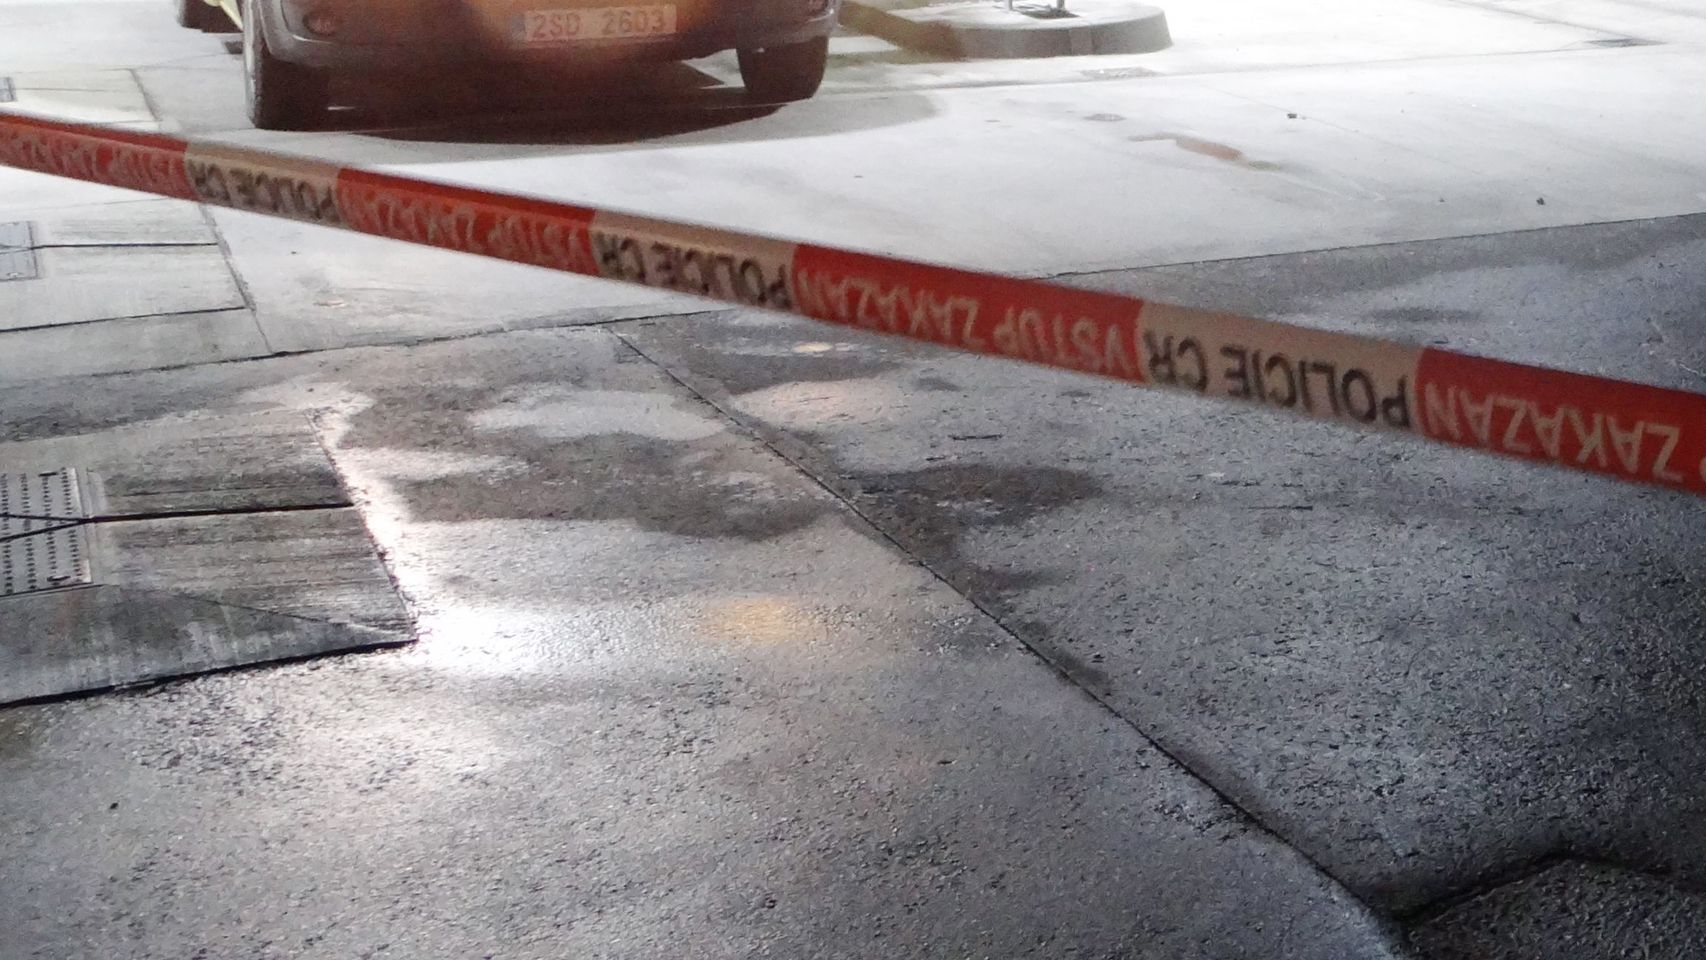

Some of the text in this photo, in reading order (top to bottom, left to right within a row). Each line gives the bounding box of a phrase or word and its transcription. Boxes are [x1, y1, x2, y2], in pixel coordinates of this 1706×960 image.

[600, 9, 665, 35] 2603
[993, 304, 1137, 376] VSTUP
[1220, 345, 1412, 428] POLICIE
